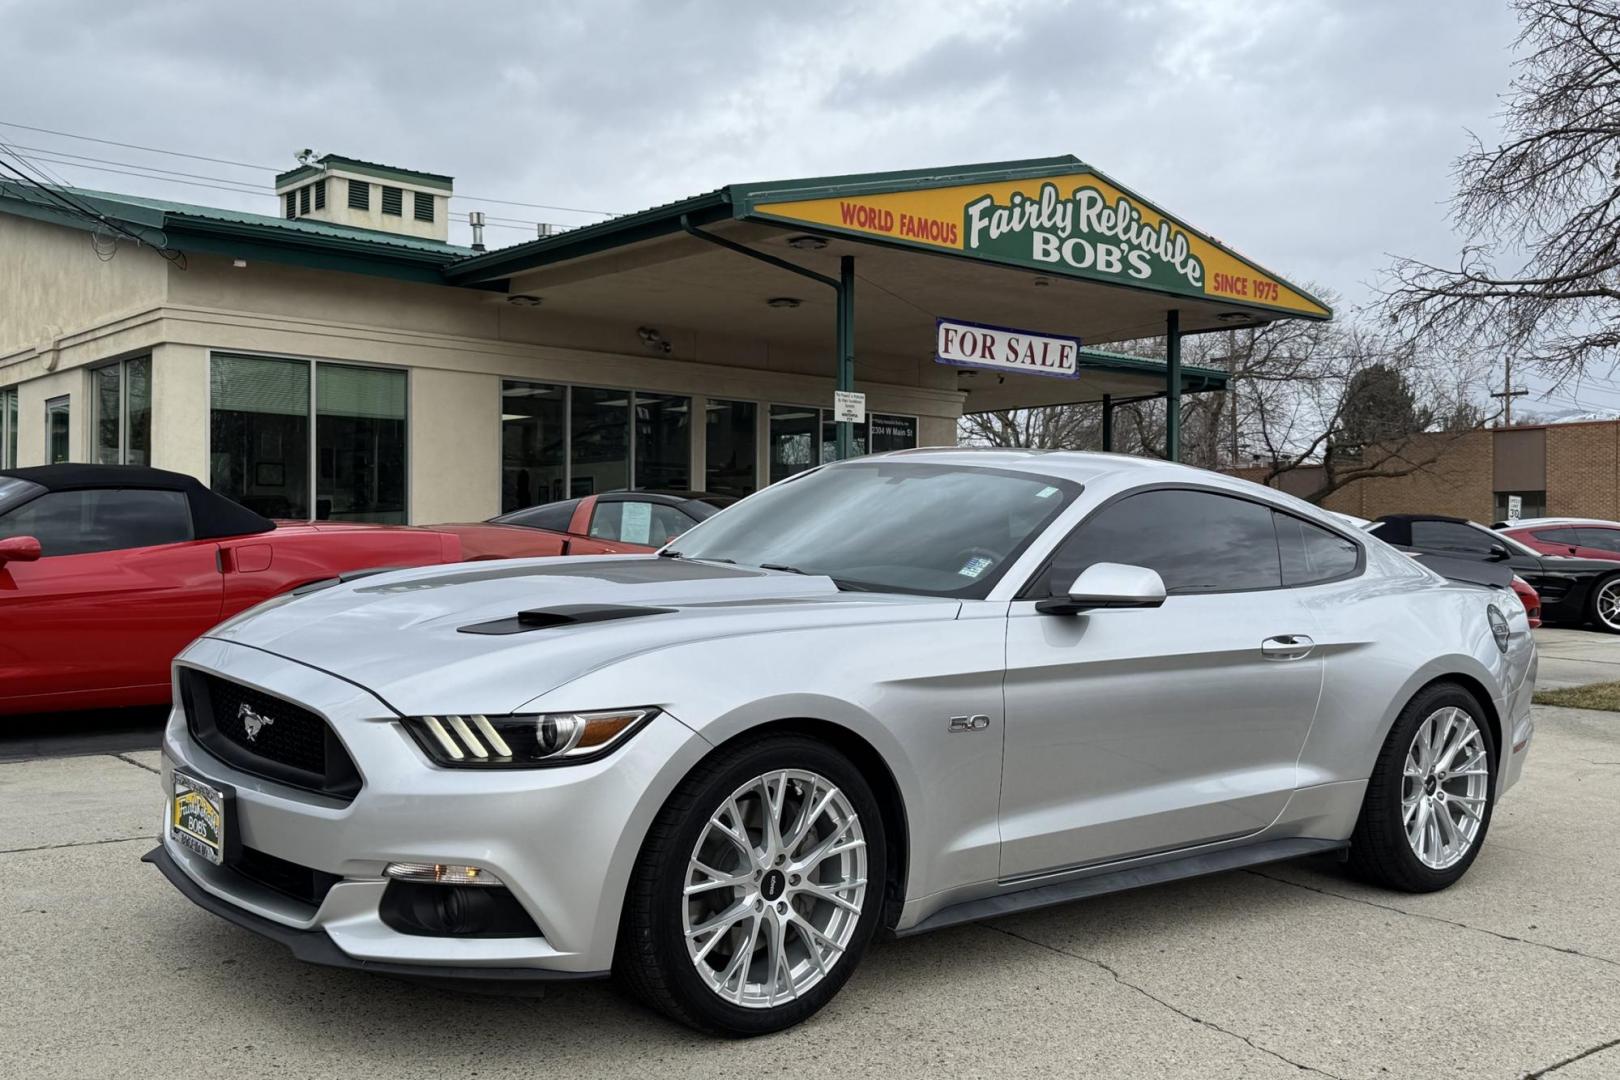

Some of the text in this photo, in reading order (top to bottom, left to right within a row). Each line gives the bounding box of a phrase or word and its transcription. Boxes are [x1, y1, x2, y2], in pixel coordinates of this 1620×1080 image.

[840, 201, 957, 245] WORLD FAMOUS
[968, 186, 1202, 287] Fairly Reliable
[1033, 231, 1152, 279] BOB'S
[1214, 272, 1279, 301] SINCE 1975
[942, 327, 1073, 369] FOR SALE
[885, 427, 892, 435] W
[892, 427, 906, 436] Main
[948, 714, 990, 733] 5.0
